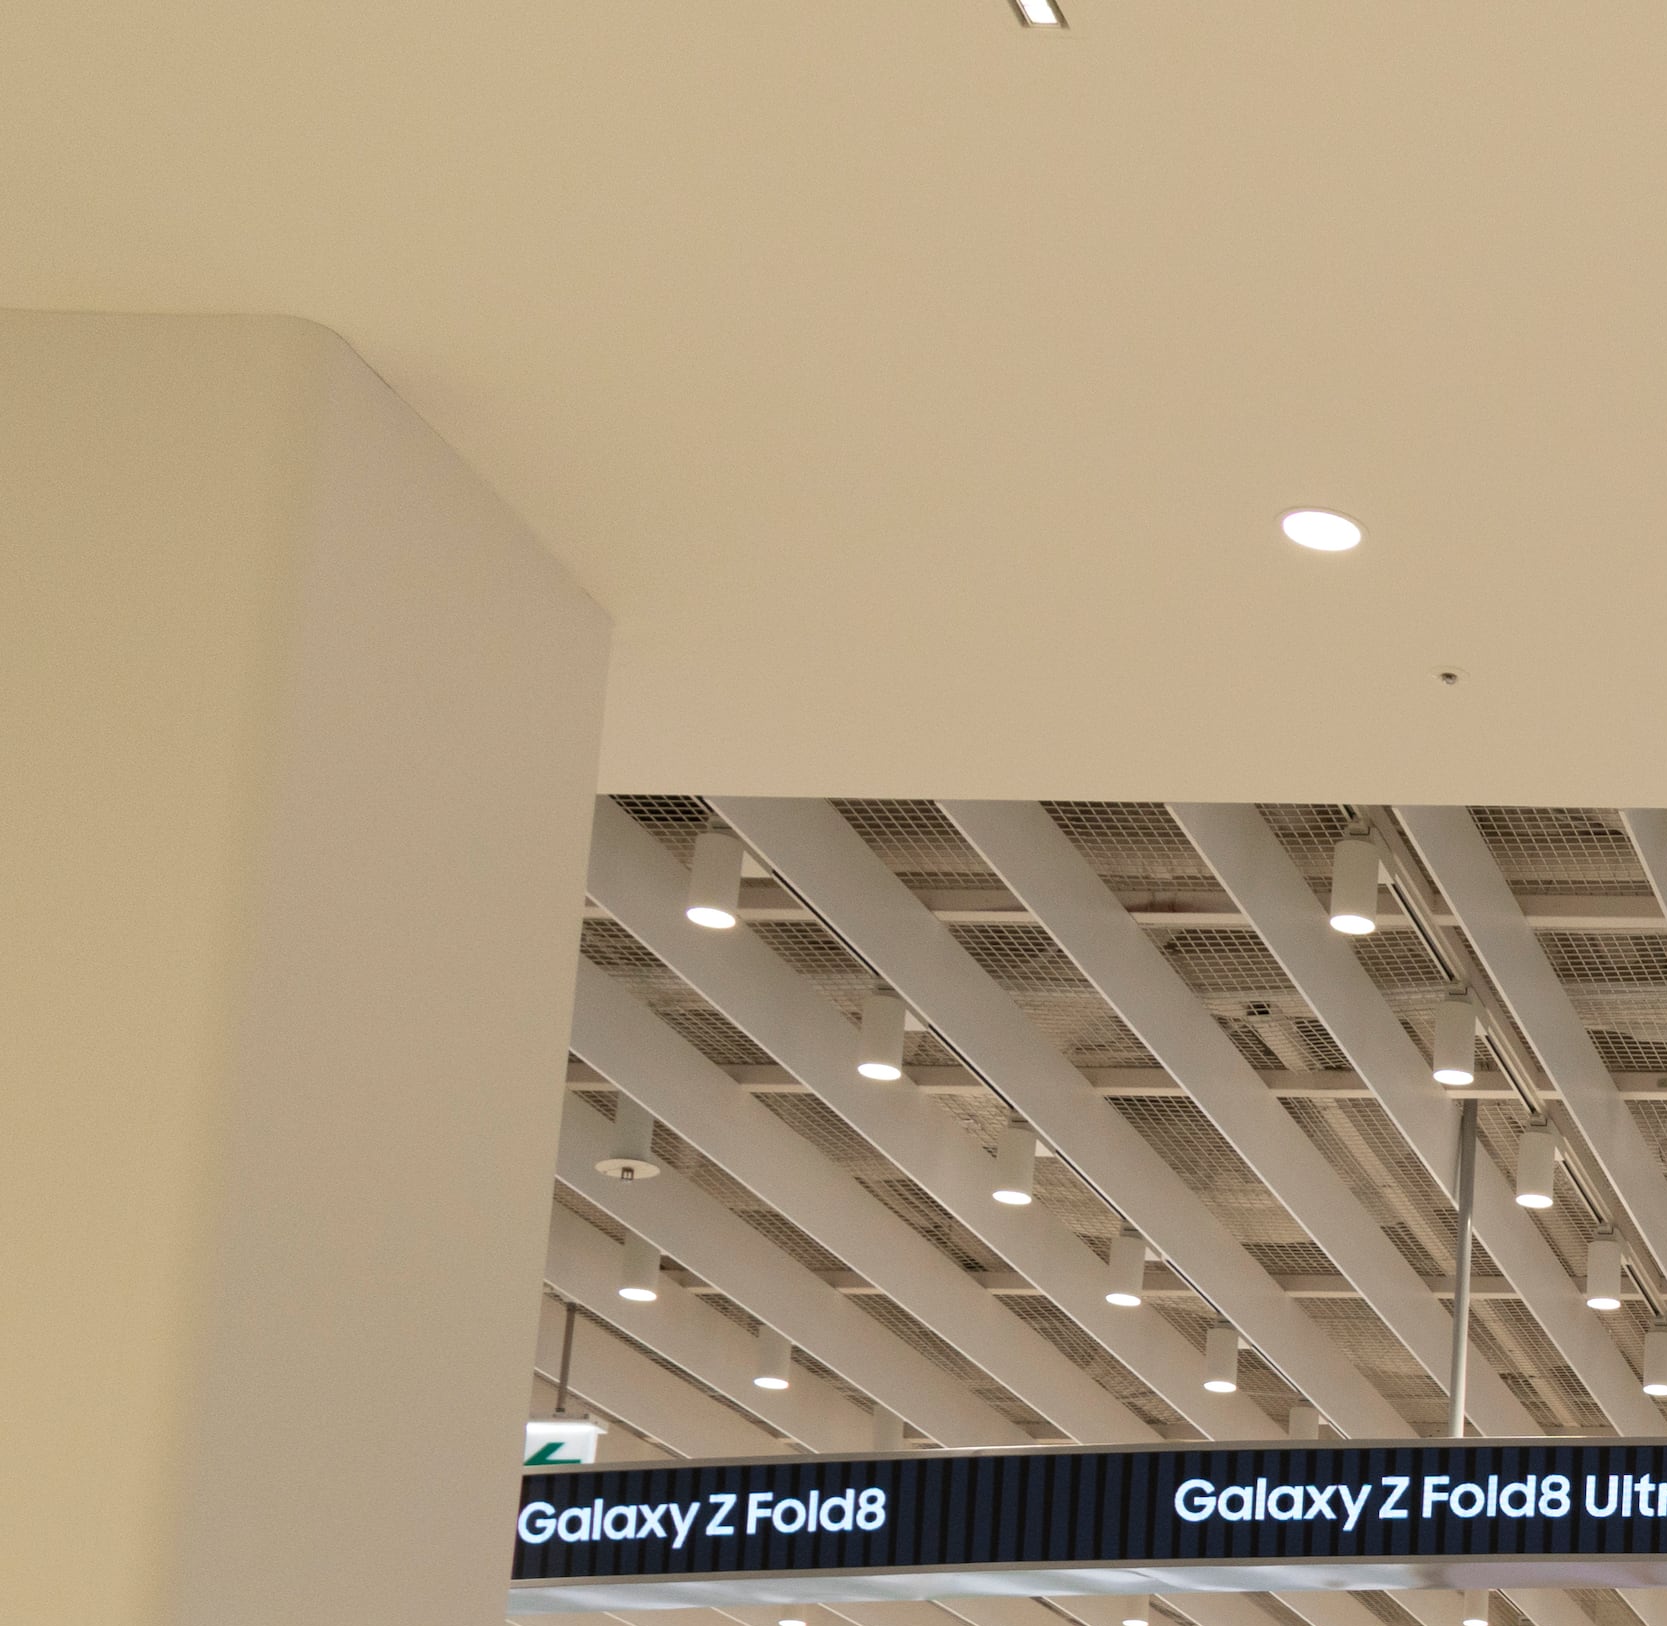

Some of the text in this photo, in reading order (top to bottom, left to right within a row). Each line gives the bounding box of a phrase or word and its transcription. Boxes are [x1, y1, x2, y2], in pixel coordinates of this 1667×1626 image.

[516, 1488, 885, 1548] Galaxy Z Fold8
[1175, 1478, 1371, 1530] Galaxy
[1379, 1477, 1408, 1518] Z
[1423, 1475, 1570, 1517] Fold8
